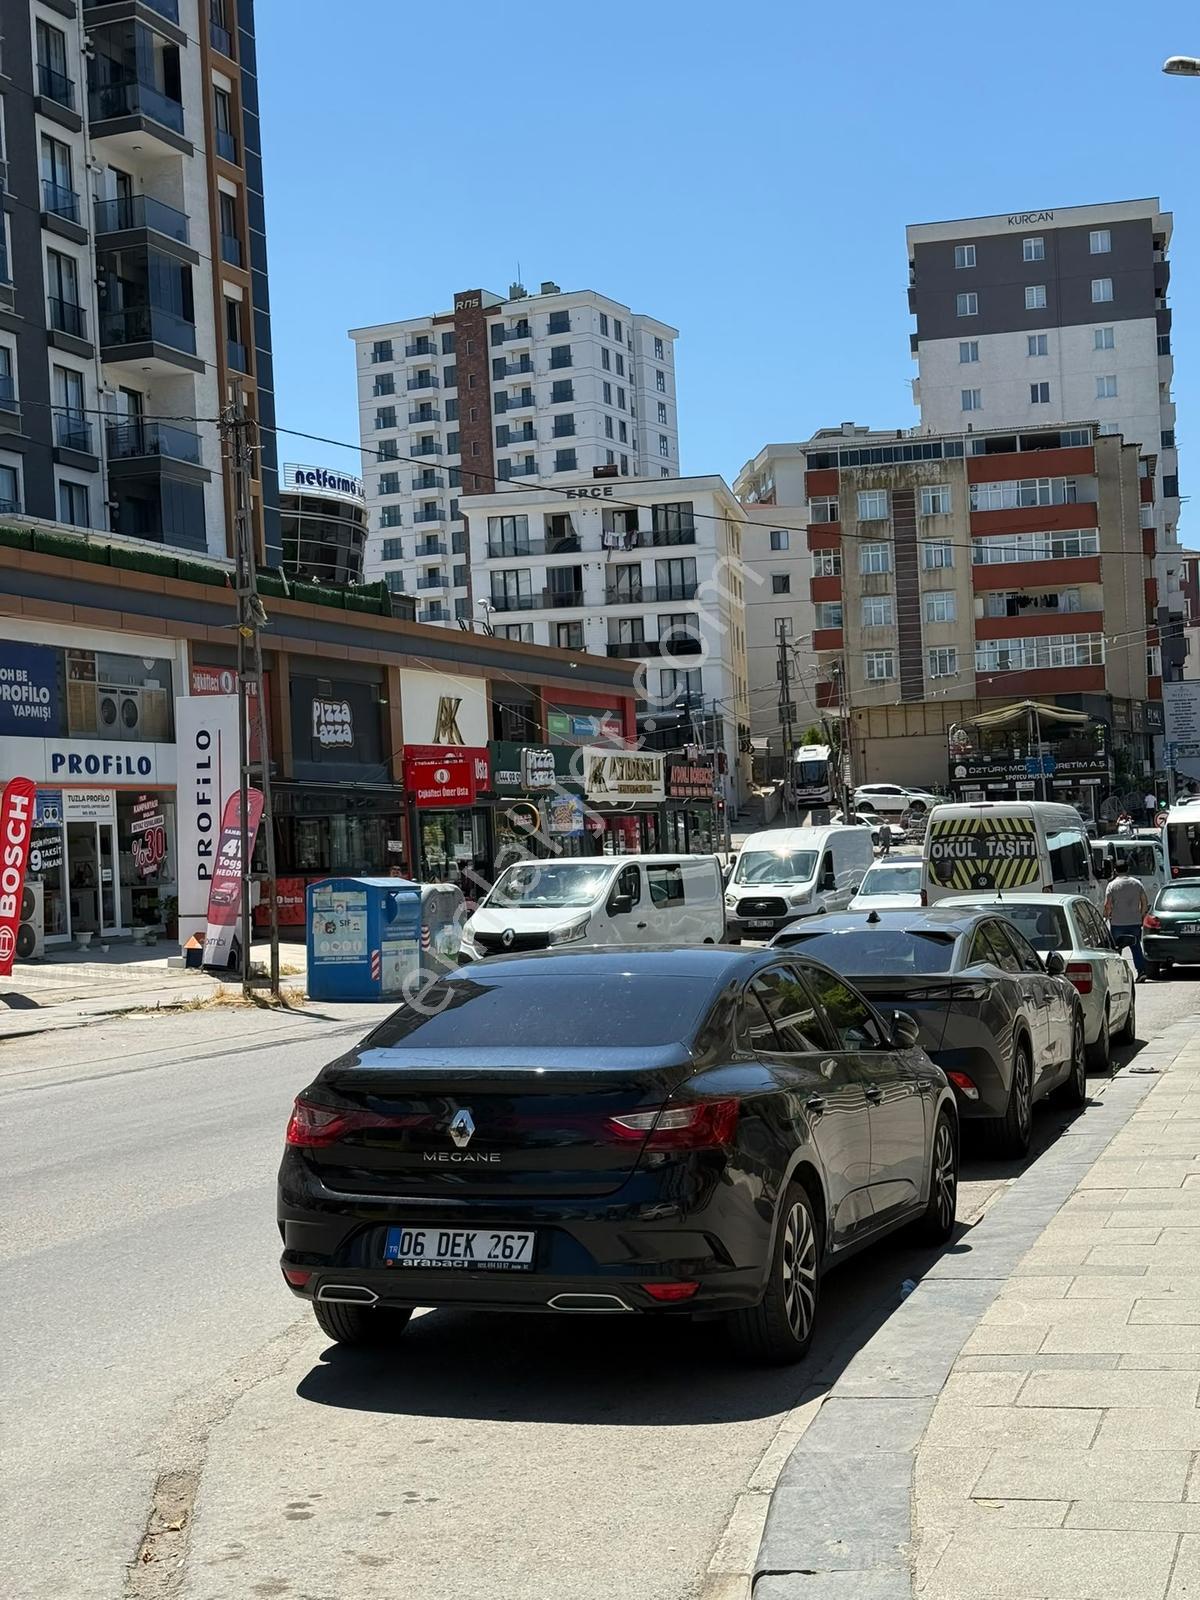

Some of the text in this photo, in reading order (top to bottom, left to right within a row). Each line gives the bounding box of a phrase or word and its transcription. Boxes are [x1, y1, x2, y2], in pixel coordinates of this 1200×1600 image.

[1008, 212, 1053, 226] KURCAN
[295, 469, 356, 494] netfarma
[566, 487, 613, 499] ERCE
[0, 668, 28, 682] OH BE
[0, 681, 50, 704] ROFİLO
[0, 794, 30, 918] BOSCH
[931, 840, 1036, 859] OKUL TAŞITI
[30, 849, 42, 871] 9
[423, 1151, 501, 1162] MEGANE
[400, 1231, 530, 1260] 06 DEK 267
